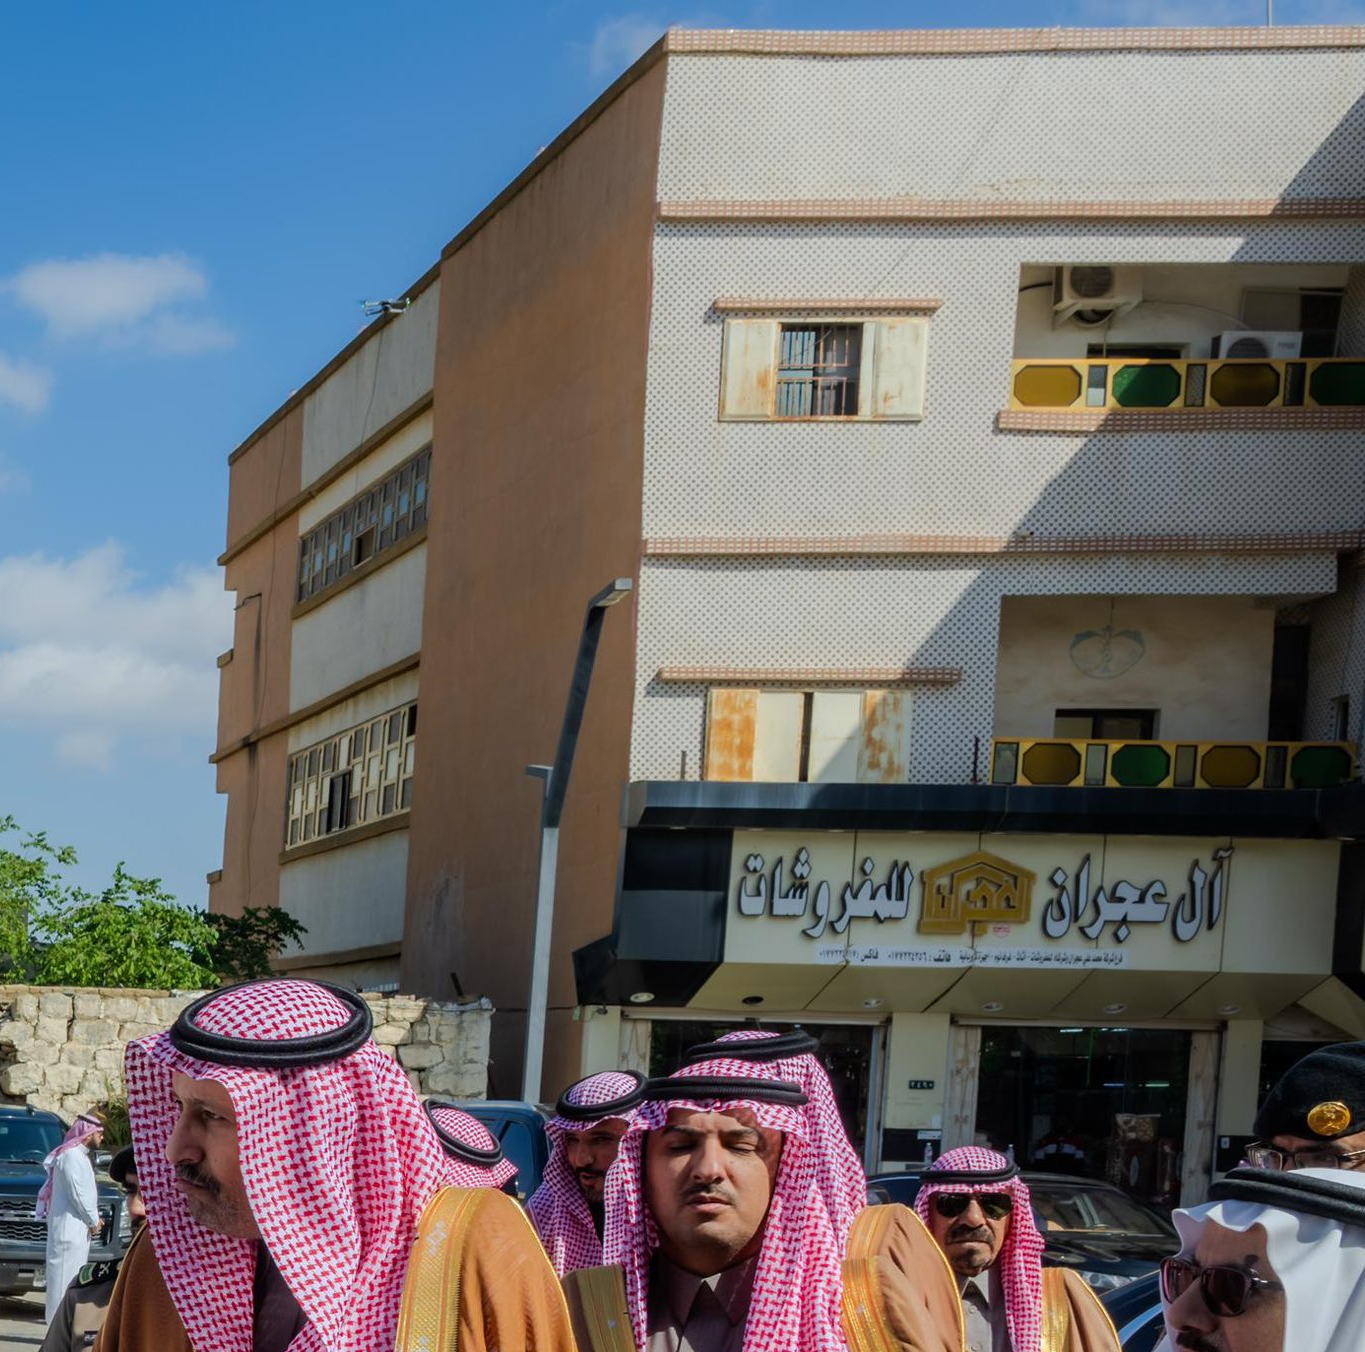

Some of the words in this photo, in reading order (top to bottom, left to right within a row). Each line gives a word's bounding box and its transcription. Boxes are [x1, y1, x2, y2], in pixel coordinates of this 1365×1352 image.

[738, 847, 915, 939] للمفروشات
[1042, 853, 1170, 944] عجران
[1172, 847, 1235, 942] آل
[861, 947, 879, 962] فاكس
[933, 949, 951, 963] هاتف
